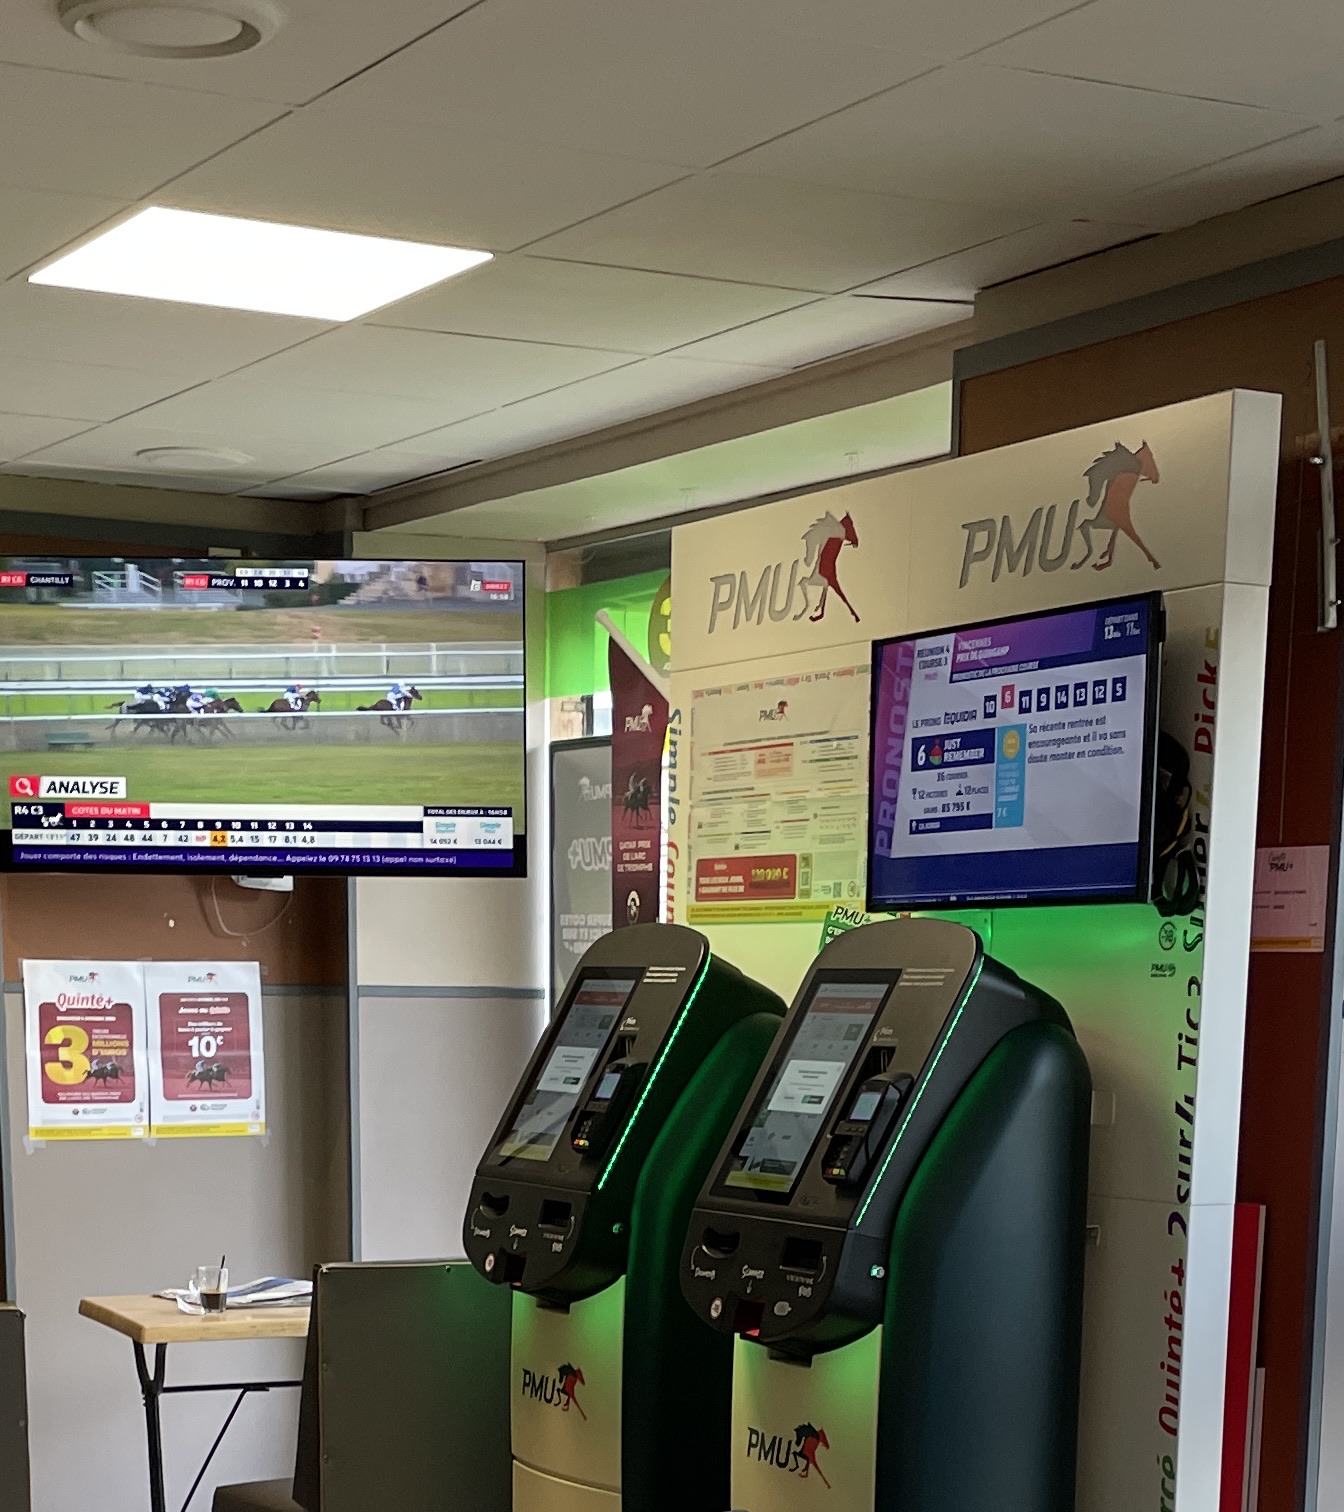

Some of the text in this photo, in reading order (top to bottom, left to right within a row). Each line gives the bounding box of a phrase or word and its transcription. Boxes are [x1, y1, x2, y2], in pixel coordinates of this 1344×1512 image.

[959, 500, 1081, 589] PMU
[708, 558, 801, 634] PMU
[986, 701, 995, 713] 10
[1040, 694, 1047, 706] 9
[1057, 691, 1067, 703] 14
[1076, 688, 1086, 701] 13
[1095, 686, 1105, 698] 12
[917, 744, 926, 766] 6
[46, 780, 120, 795] ANALYSE
[56, 993, 115, 1011] Quinté+
[44, 1025, 89, 1085] 3
[521, 1366, 556, 1407] PMU
[746, 1426, 793, 1470] PMU
